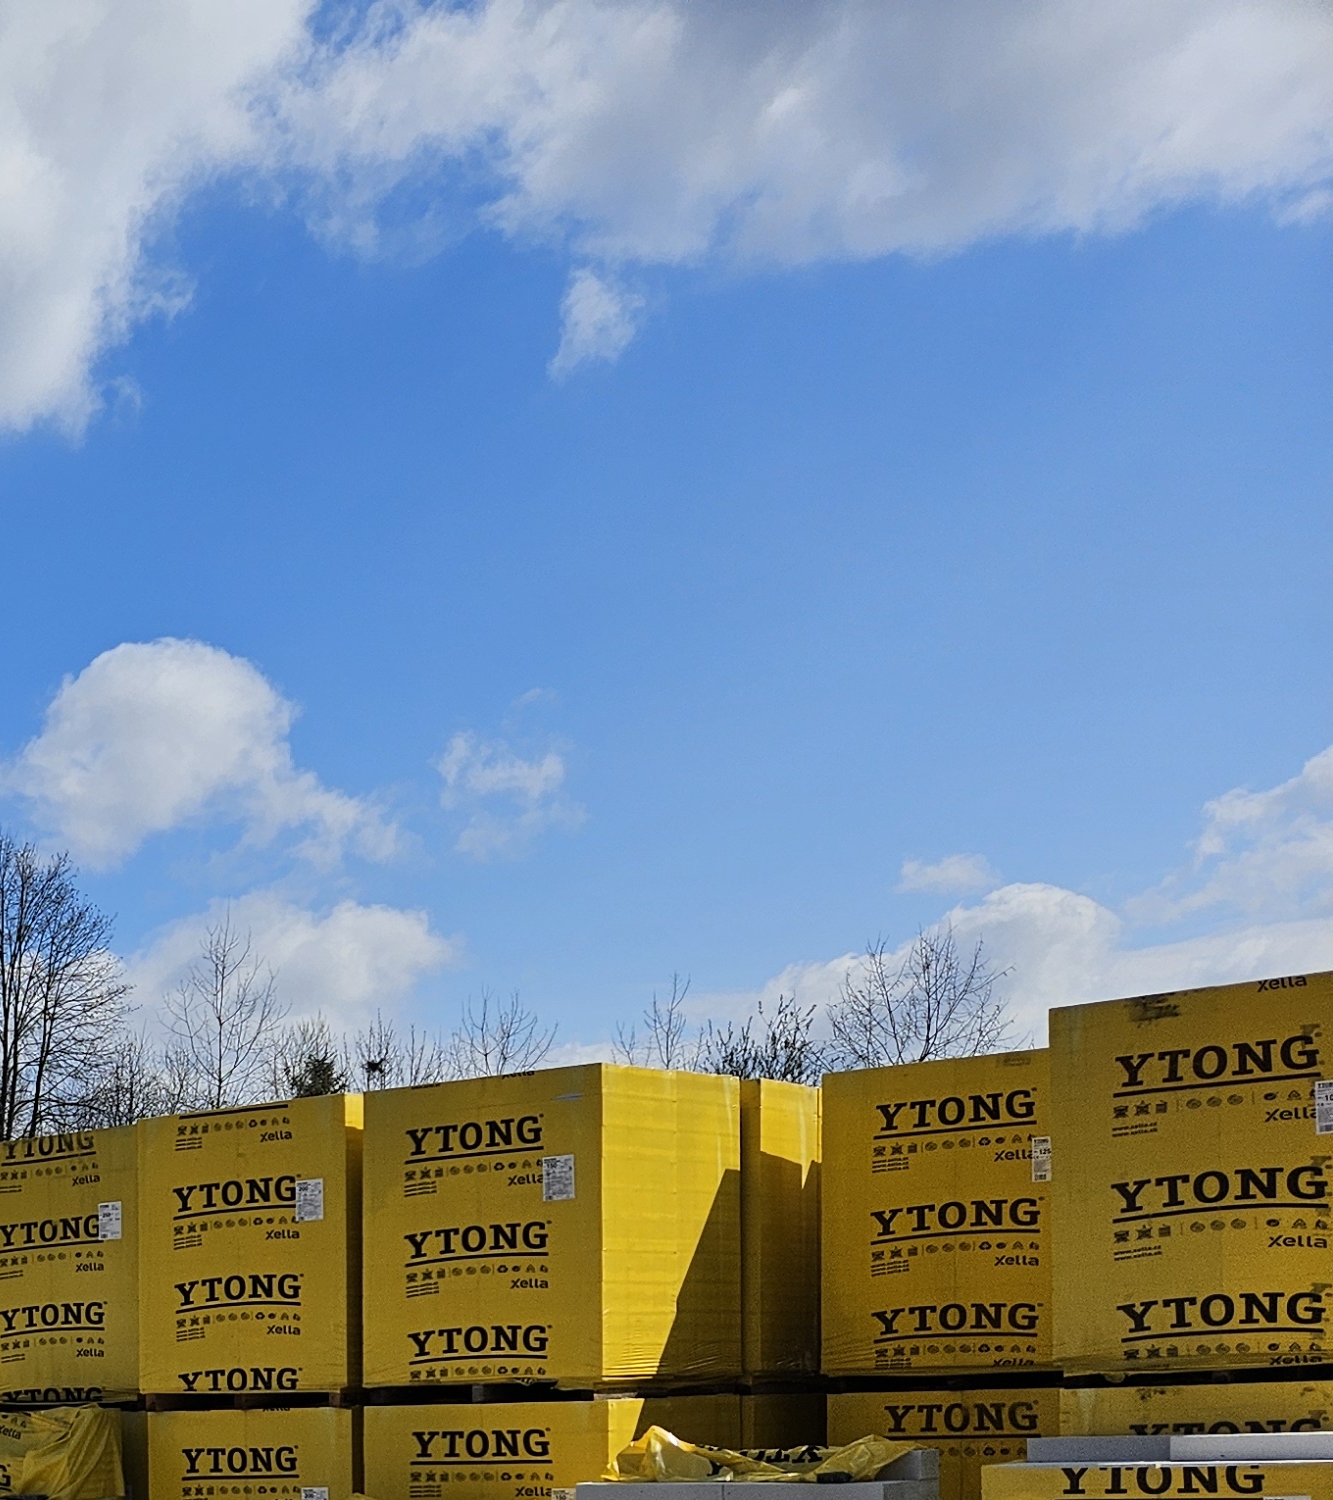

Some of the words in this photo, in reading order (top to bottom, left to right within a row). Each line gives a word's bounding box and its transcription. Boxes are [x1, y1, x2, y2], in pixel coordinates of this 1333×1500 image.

[1114, 1034, 1320, 1088] YTONG
[875, 1089, 1036, 1132] YTONG
[405, 1115, 543, 1156] YTONG
[172, 1175, 297, 1213] YTONG
[1110, 1165, 1329, 1214] YTONG
[870, 1197, 1041, 1237] YTONG
[404, 1221, 549, 1259] YTONG
[174, 1273, 302, 1307] YTONG
[0, 1301, 106, 1332] YTONG
[871, 1303, 1040, 1336] YTONG
[1116, 1292, 1327, 1333] YTONG
[407, 1325, 549, 1358] YTONG
[178, 1367, 299, 1392] YTONG
[884, 1400, 1039, 1433] YTONG
[181, 1446, 298, 1474] YTONG
[412, 1428, 550, 1458] YTONG
[1060, 1465, 1266, 1495] YTONG
